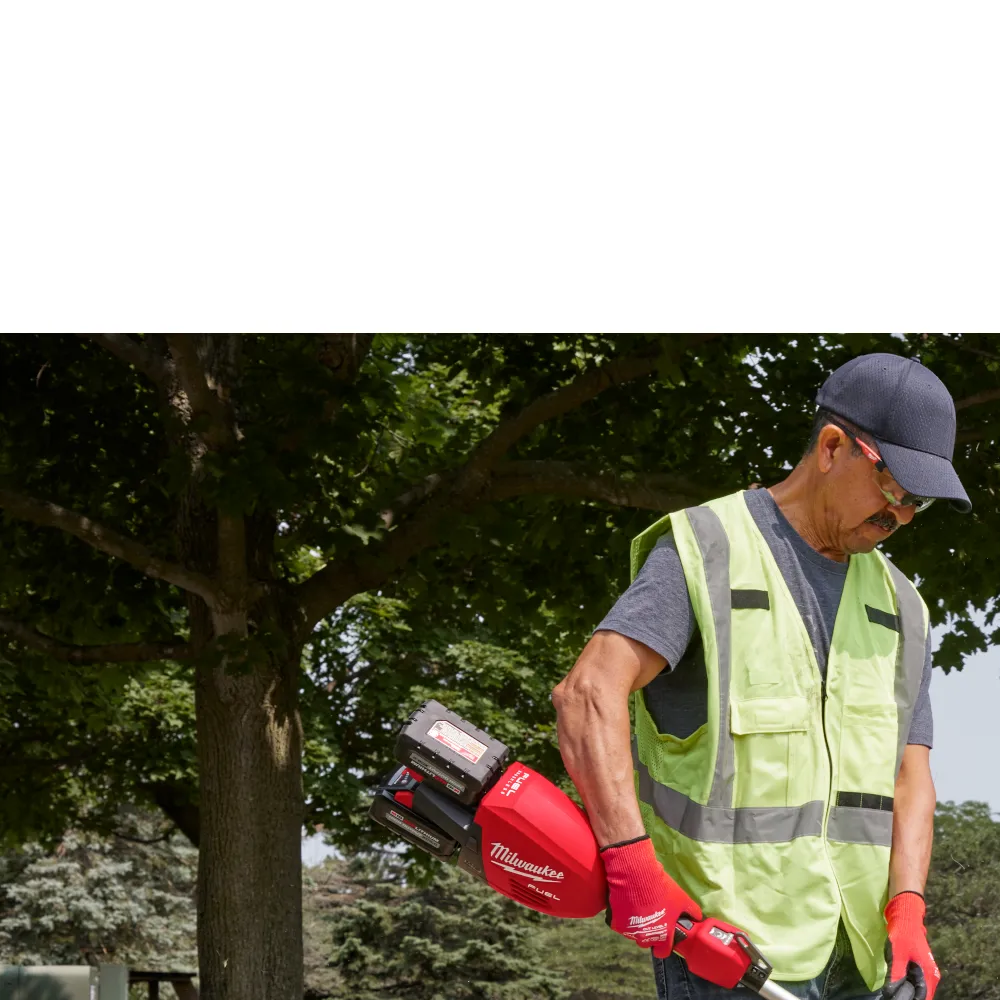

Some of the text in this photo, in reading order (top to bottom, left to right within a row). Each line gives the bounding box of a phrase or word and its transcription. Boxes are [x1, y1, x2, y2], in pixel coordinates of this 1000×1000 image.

[505, 772, 530, 797] FUEL
[491, 843, 564, 879] Milwaukee
[528, 884, 560, 901] FUEL
